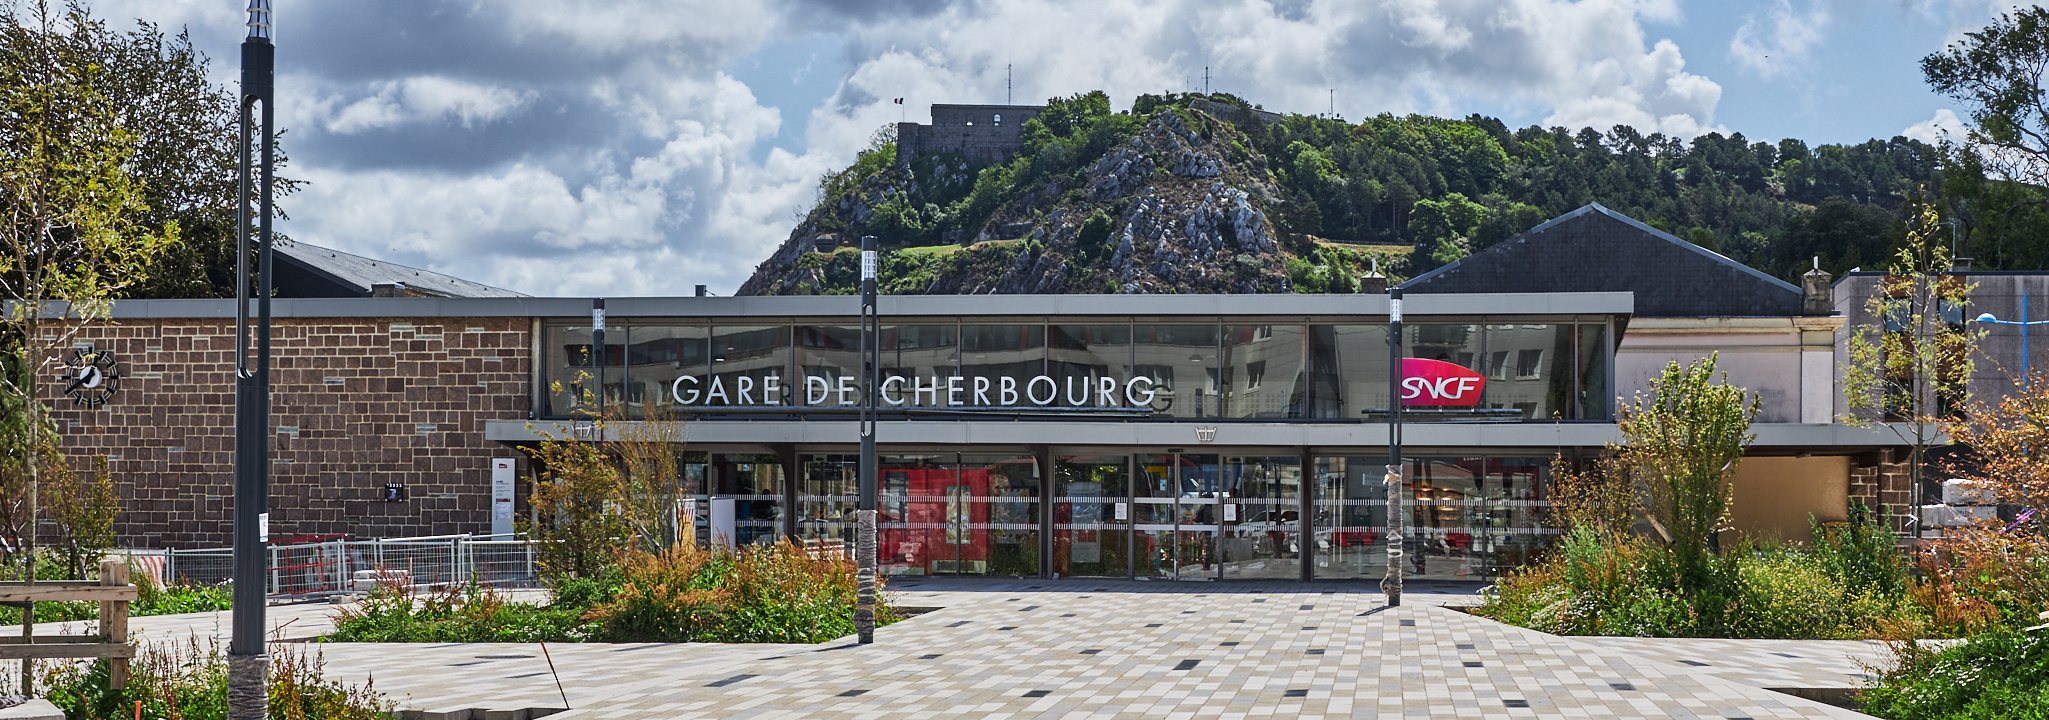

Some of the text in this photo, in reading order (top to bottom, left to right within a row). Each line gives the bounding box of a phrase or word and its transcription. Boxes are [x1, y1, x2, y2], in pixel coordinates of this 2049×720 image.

[672, 375, 1155, 406] GARE DE CHERBOURG
[1401, 377, 1480, 400] SNCF
